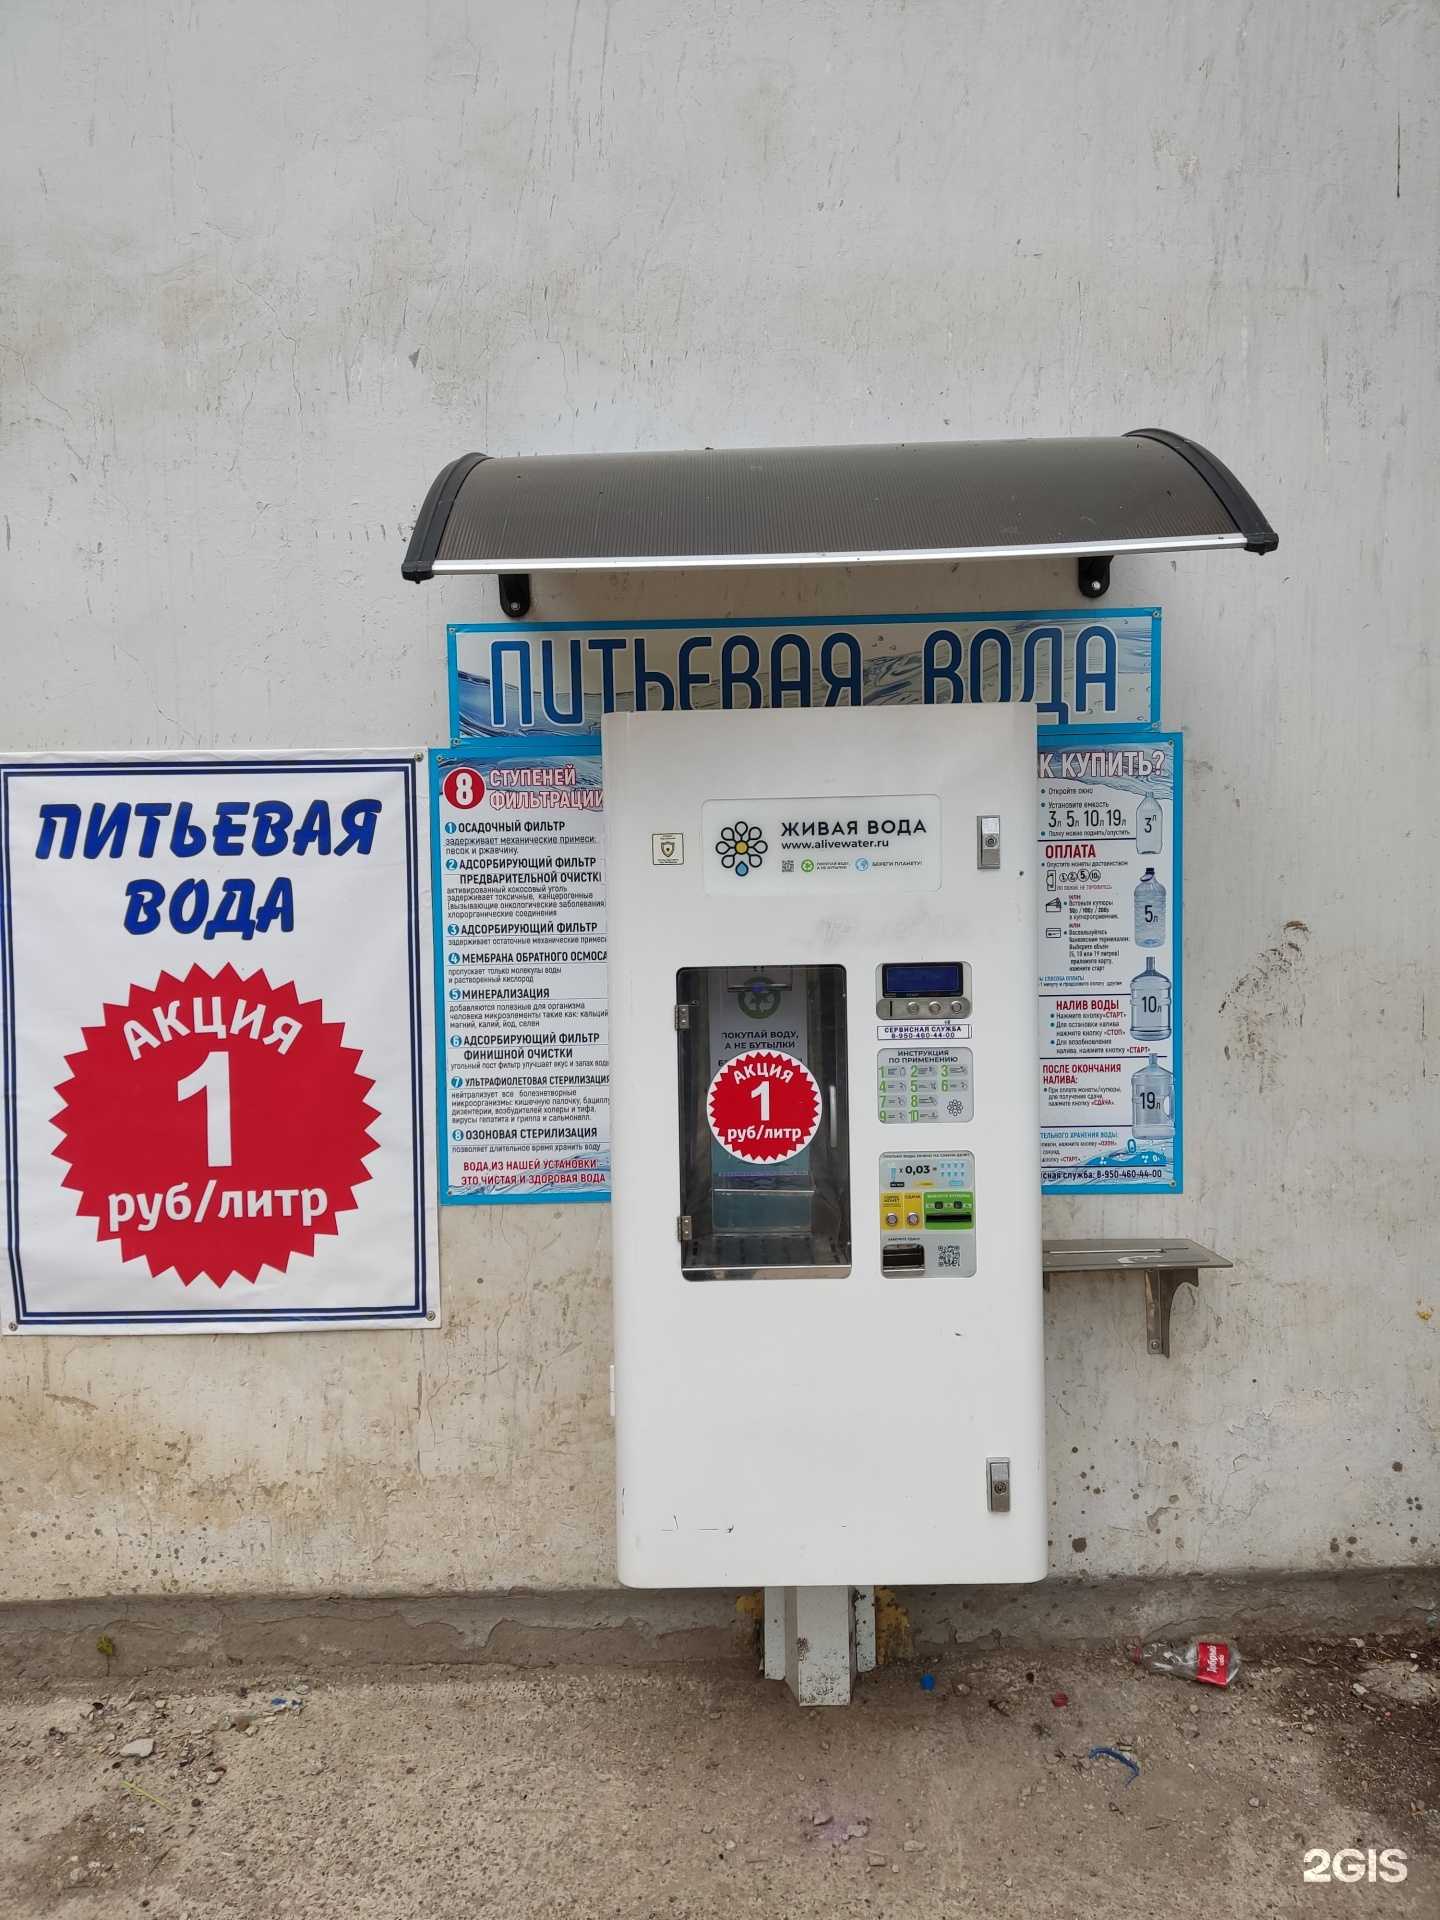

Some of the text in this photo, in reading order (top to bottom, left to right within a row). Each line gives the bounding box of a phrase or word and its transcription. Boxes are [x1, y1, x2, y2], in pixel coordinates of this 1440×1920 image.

[490, 625, 1118, 726] ПИТЬЕВАЯ ВОДА
[1062, 749, 1165, 777] КУПИТЬ?
[489, 764, 576, 787] СТУПЕНЕЙ
[456, 773, 473, 805] 8
[35, 799, 382, 859] ПИТЬЕВАЯ
[458, 822, 522, 833] ОСАДОЧНЫЙ
[524, 821, 565, 832] ФИЛЬТР
[781, 819, 927, 837] ЖИВАЯ ВОДА
[446, 837, 498, 846] задерживает
[781, 839, 889, 850] www.alivewater.ru
[1045, 844, 1096, 858] ОПЛАТА
[459, 857, 552, 870] АДСОРБИРУЮЩИЙ
[555, 857, 596, 868] ФИЛЬТР
[460, 871, 602, 885] ПРЕДВАРИТЕЛЬНОЙ ОЧИСТК
[124, 877, 295, 940] ВОДА
[461, 922, 554, 935] АДСОРБИРУЮЩИЙ
[557, 922, 597, 933] ФИЛЬТР
[462, 953, 513, 963] МЕМБРАНА
[516, 952, 568, 963] ОБРАТНОГО
[462, 988, 550, 1000] МИНЕРАЛИЗАЦИЯ
[1056, 999, 1119, 1010] НАЛИВ ВОДЫ
[123, 996, 303, 1061] АКЦИЯ
[464, 1032, 557, 1046] АДСОРБИРУЮЩИЙ
[560, 1032, 600, 1043] ФИЛЬТР
[771, 1031, 799, 1040] ВОДУ,
[749, 1041, 795, 1049] БУТЫЛКИ
[464, 1047, 573, 1060] ФИНИШНОЙ ОЧИСТКИ
[733, 1063, 794, 1084] АКЦИЯ
[911, 1066, 918, 1077] 2
[941, 1065, 948, 1077] 3
[1043, 1064, 1121, 1073] ПОСЛЕ ОКОНЧАНИЯ
[465, 1077, 547, 1086] УЛЬТРАФИОЛЕТОВАЯ
[1043, 1074, 1077, 1084] НАЛИВА:
[879, 1080, 948, 1092] 4 5 6
[751, 1081, 770, 1121] 1
[879, 1095, 918, 1107] 7 8
[177, 1051, 232, 1167] 1
[879, 1111, 918, 1122] 9 10
[465, 1129, 518, 1140] ОЗОНОВАЯ
[521, 1128, 597, 1139] СТЕРИЛИЗАЦИЯ
[727, 1125, 802, 1142] руб/литр
[464, 1158, 596, 1171] ВОДА ИЗ НАШЕЙ УСТАНОВКИ
[905, 1165, 930, 1175] 0,03
[461, 1173, 605, 1185] ЭТО ЧИСТАЯ И ЗДОРОВАЯ ВОДА
[1062, 1169, 1095, 1180] служба:
[108, 1179, 328, 1232] руб/литр
